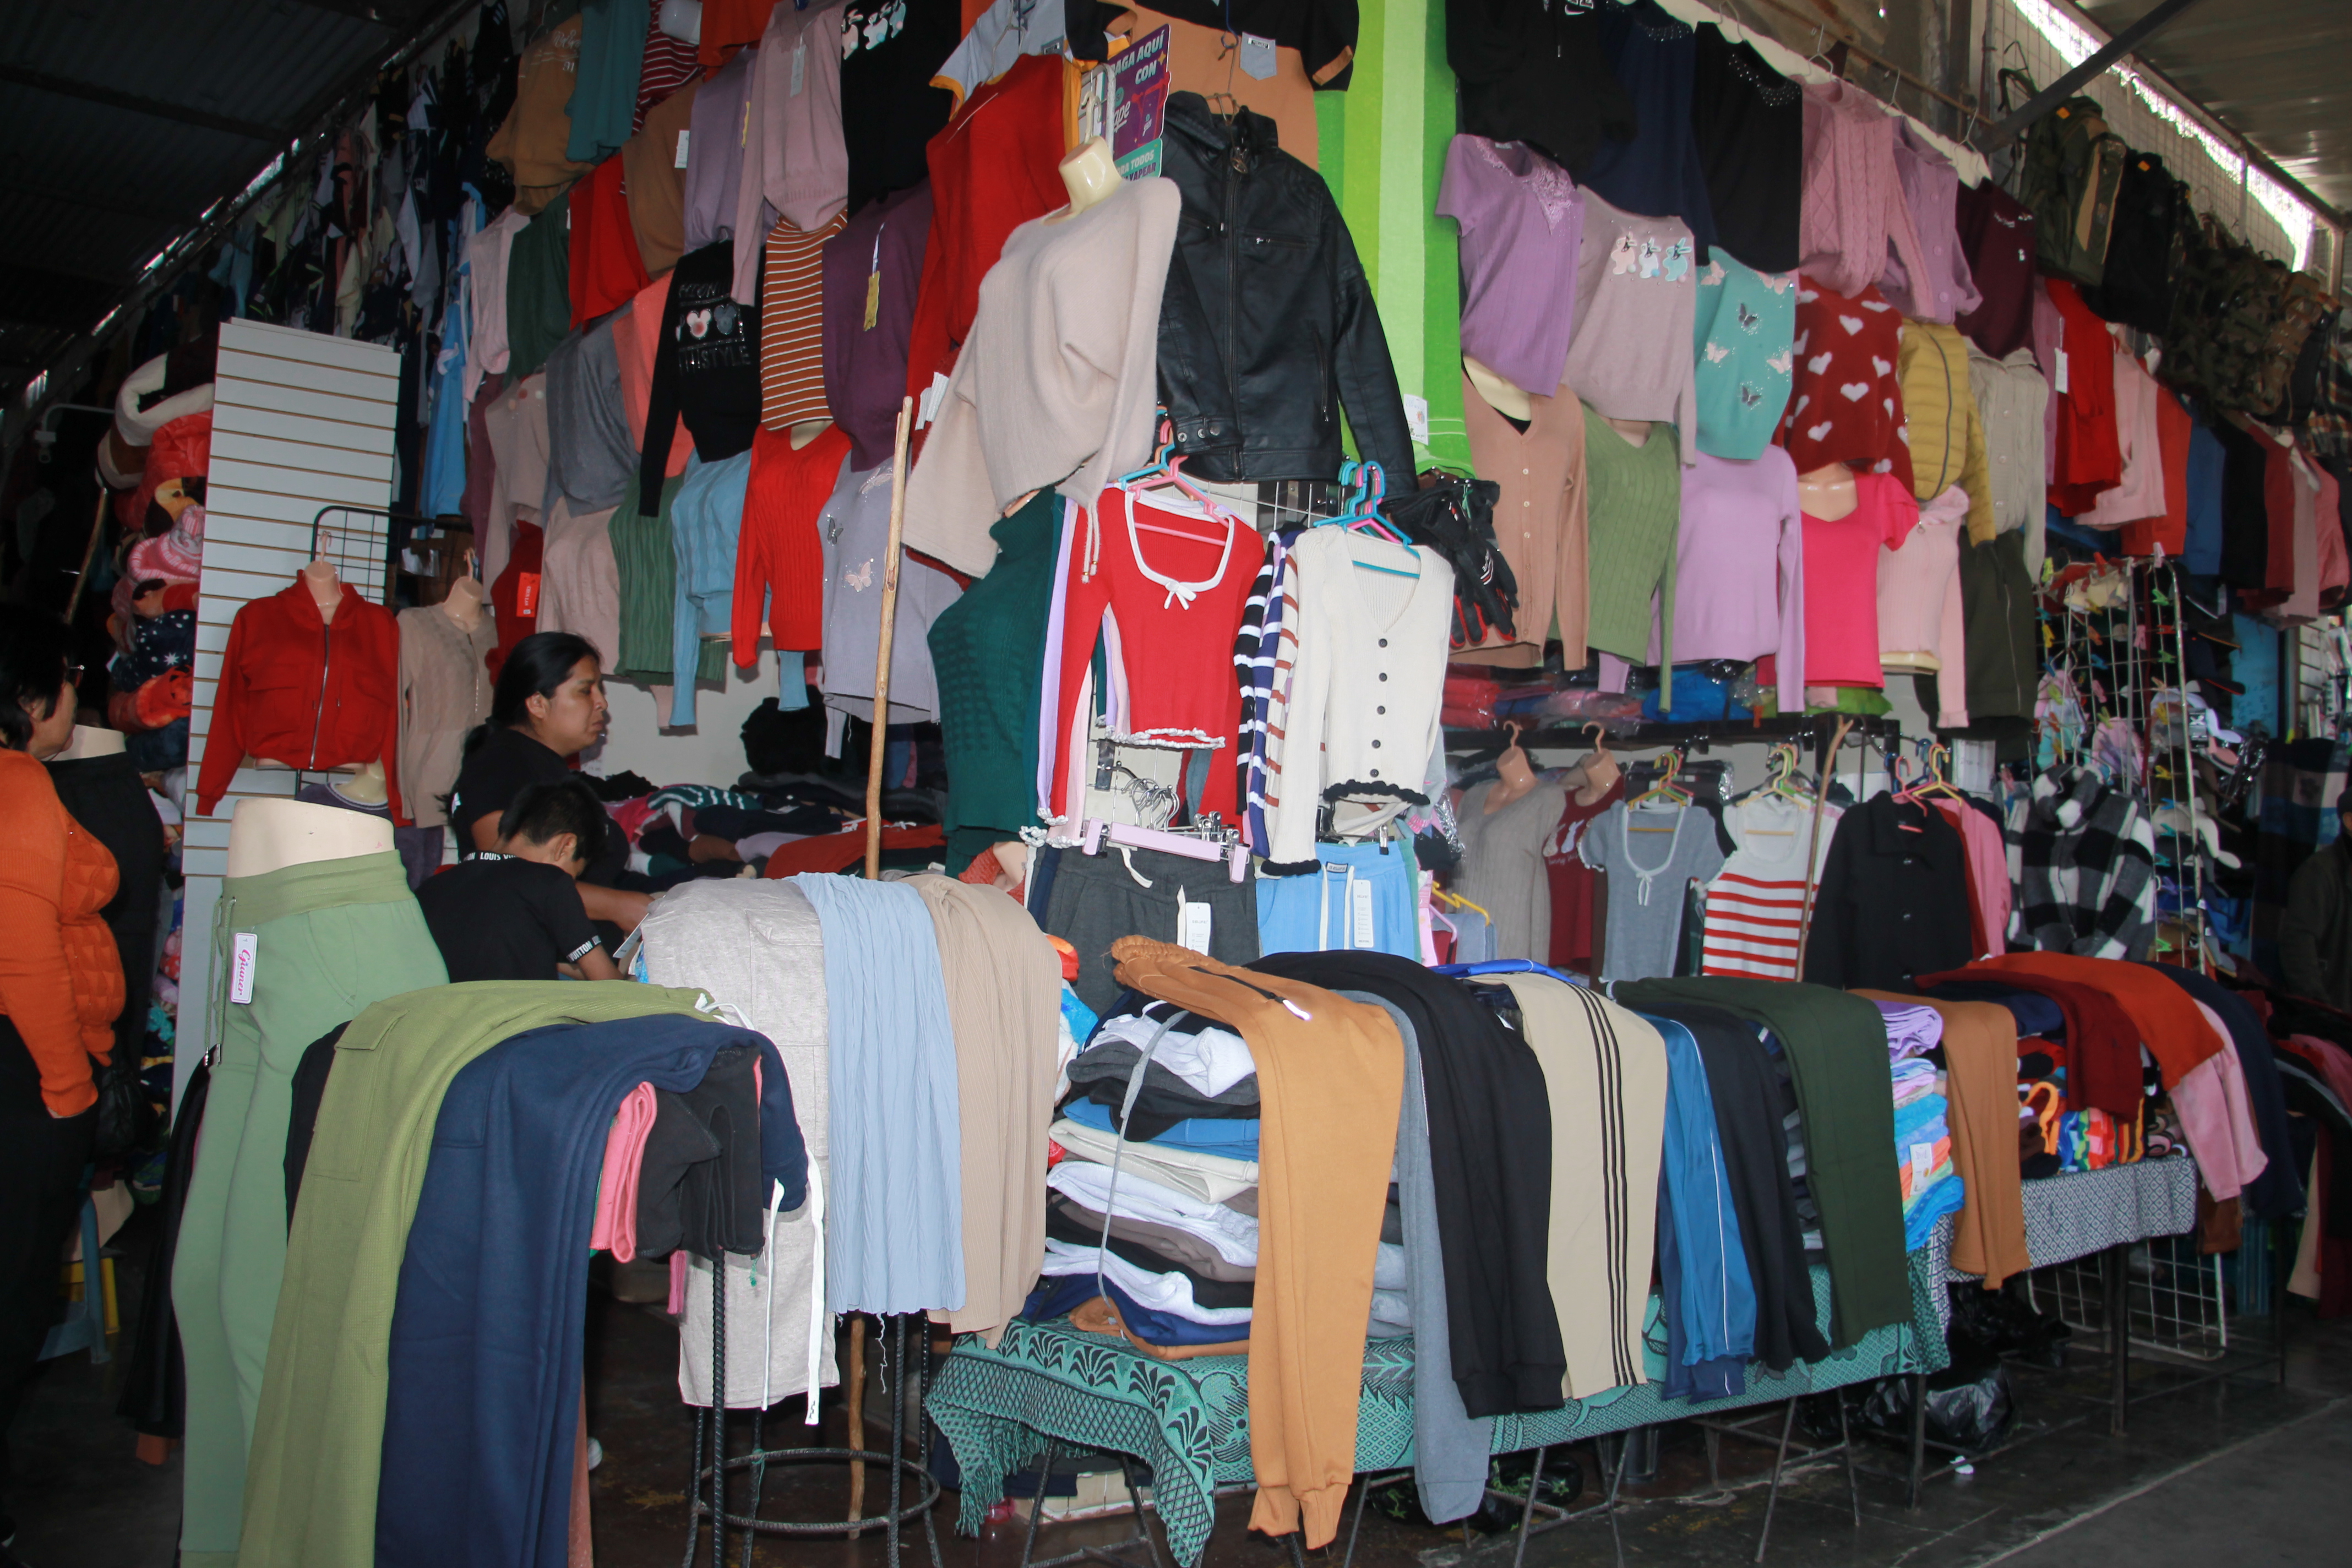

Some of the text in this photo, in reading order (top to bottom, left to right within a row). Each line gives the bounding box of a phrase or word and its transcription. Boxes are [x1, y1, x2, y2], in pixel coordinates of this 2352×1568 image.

[1136, 29, 1165, 63] AQUÍ
[1135, 59, 1157, 85] CON
[1114, 101, 1131, 133] ape
[1131, 149, 1155, 170] TODOS
[1129, 162, 1156, 182] YAPEAR
[480, 852, 501, 861] LOUIS
[568, 940, 593, 961] VUITTON
